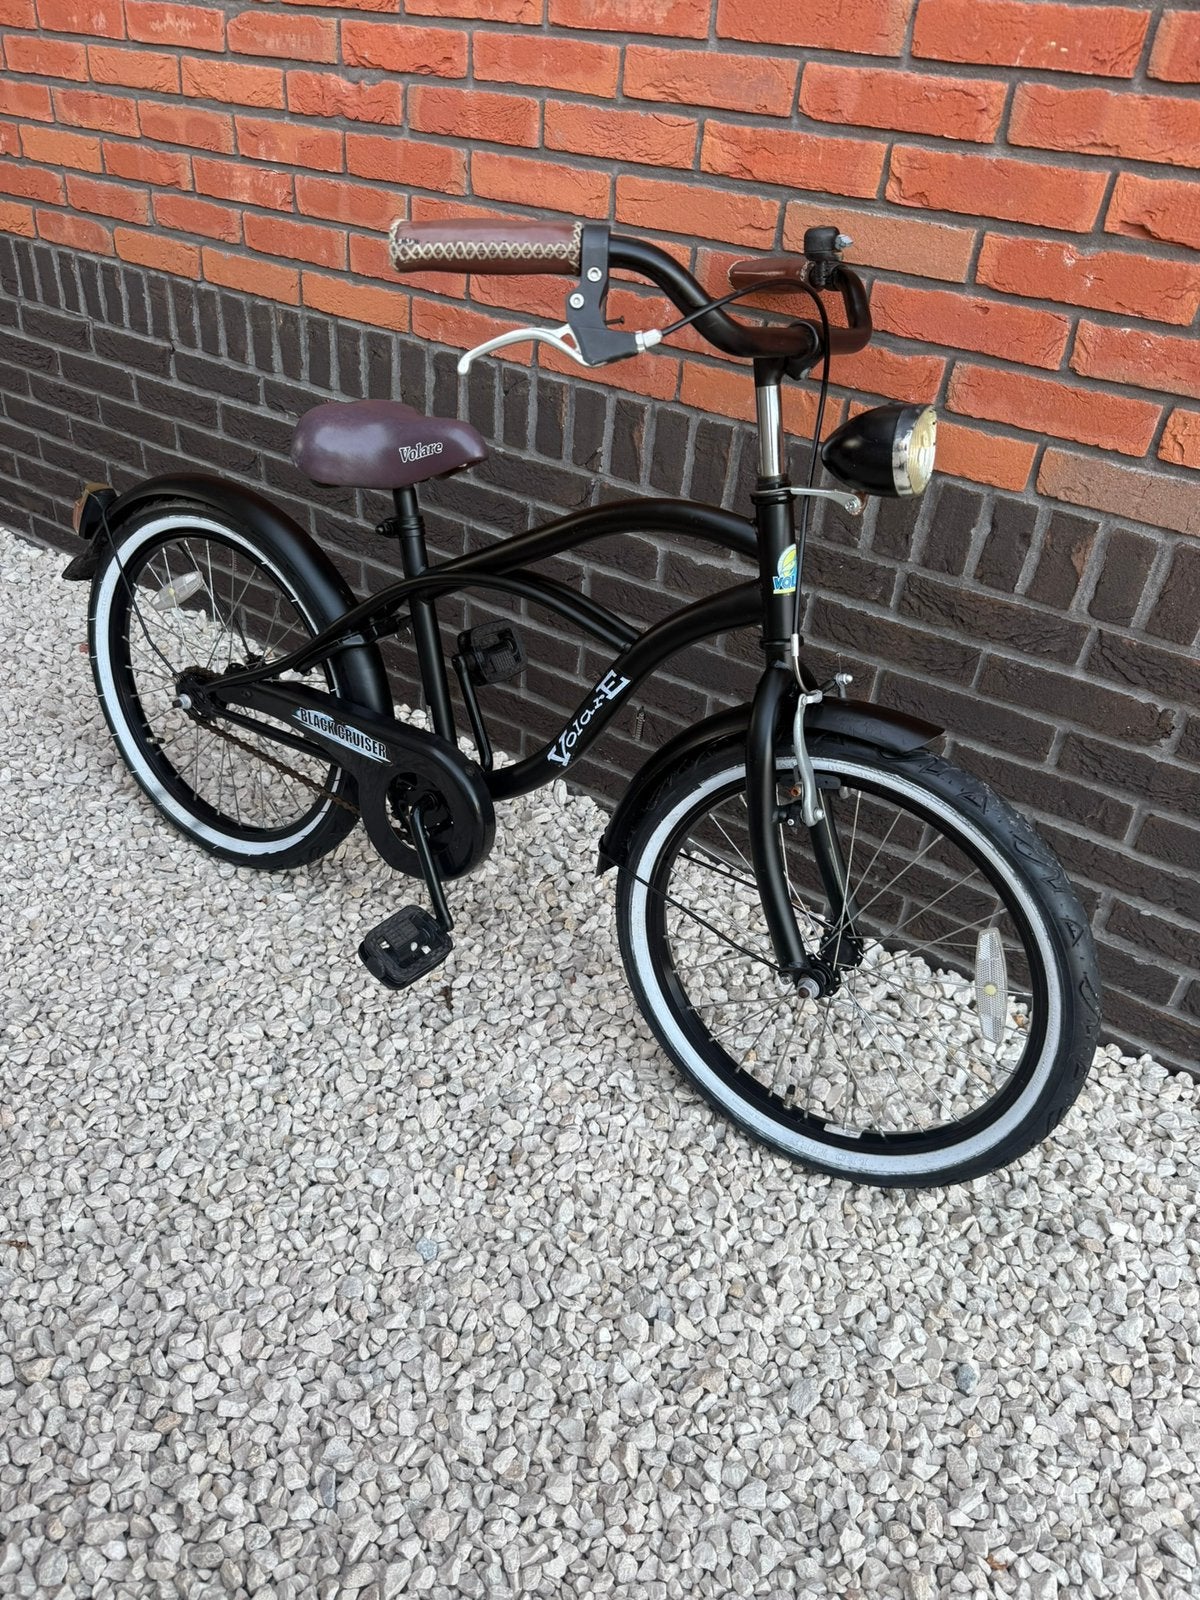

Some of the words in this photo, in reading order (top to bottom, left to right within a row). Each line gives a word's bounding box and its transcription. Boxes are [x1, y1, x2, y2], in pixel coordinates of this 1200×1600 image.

[399, 442, 443, 463] Volare
[300, 708, 337, 736] BLACK
[337, 724, 386, 758] CRUISER
